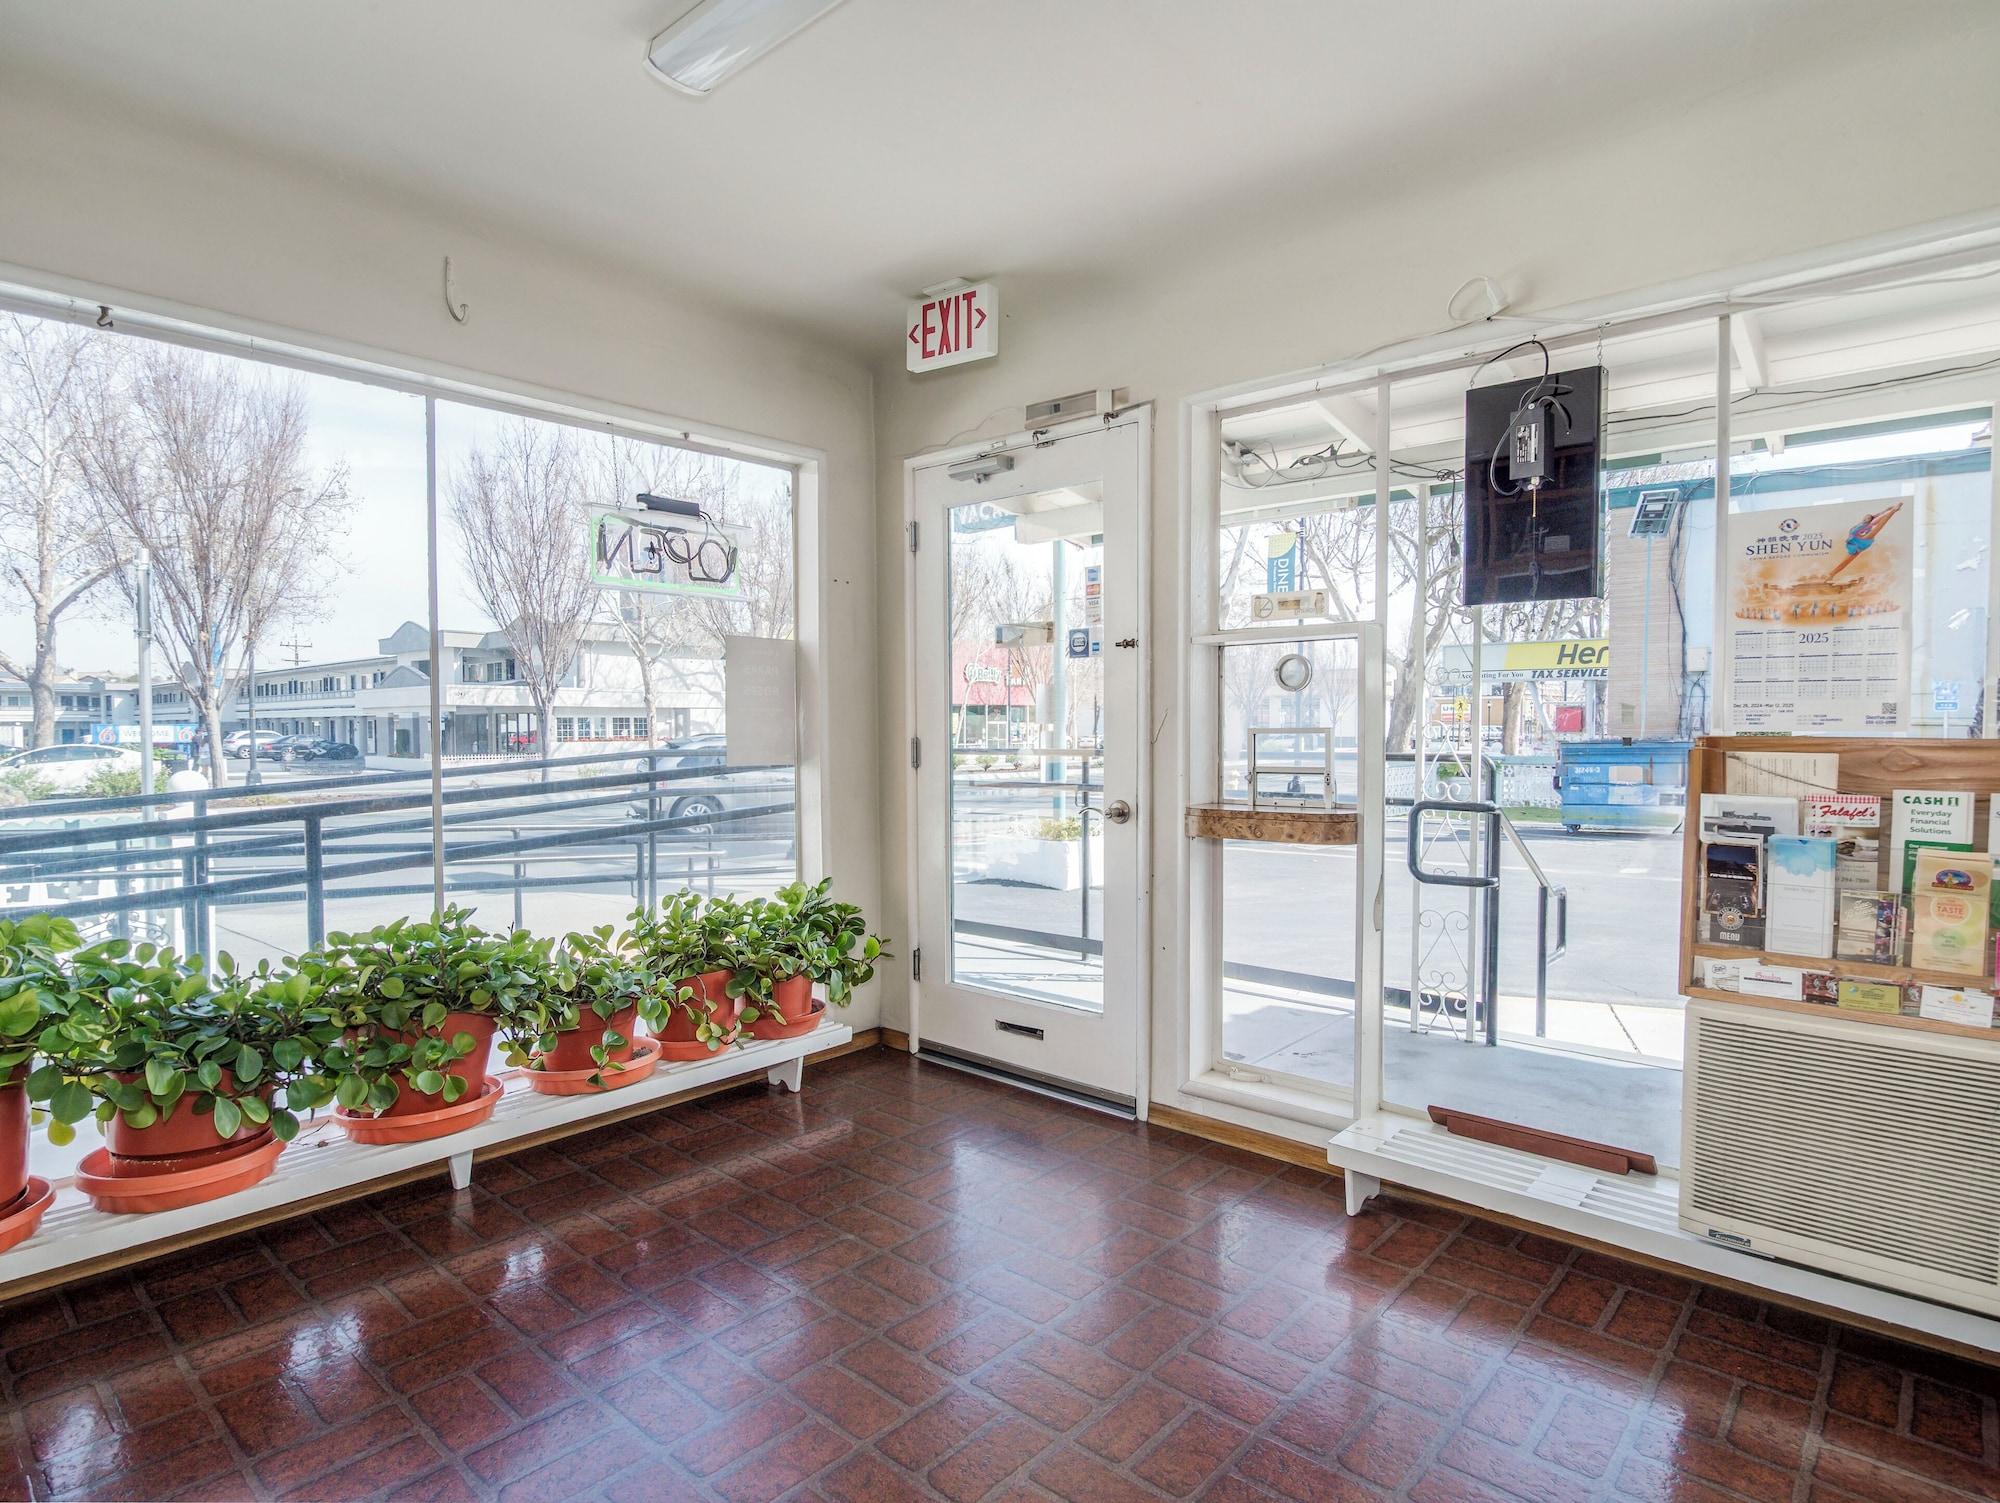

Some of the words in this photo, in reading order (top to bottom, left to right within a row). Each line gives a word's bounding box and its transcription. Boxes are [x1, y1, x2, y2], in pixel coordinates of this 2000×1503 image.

[922, 290, 976, 359] EXIT
[1803, 533, 1823, 541] 2025
[1745, 543, 1791, 556] SHEN
[1797, 539, 1833, 551] YUN
[1799, 632, 1829, 644] 2025
[1461, 672, 1496, 680] Accting
[1511, 670, 1524, 679] You
[1531, 669, 1554, 679] TAX
[1556, 668, 1608, 679] SERVICE
[1903, 795, 1943, 805] CASH
[1819, 804, 1876, 820] Falafel's
[1910, 809, 1952, 818] Everyday
[1910, 818, 1950, 826] Financial
[1910, 827, 1952, 835] Solutions
[1937, 906, 1964, 915] TASTE
[1719, 931, 1741, 941] MENU
